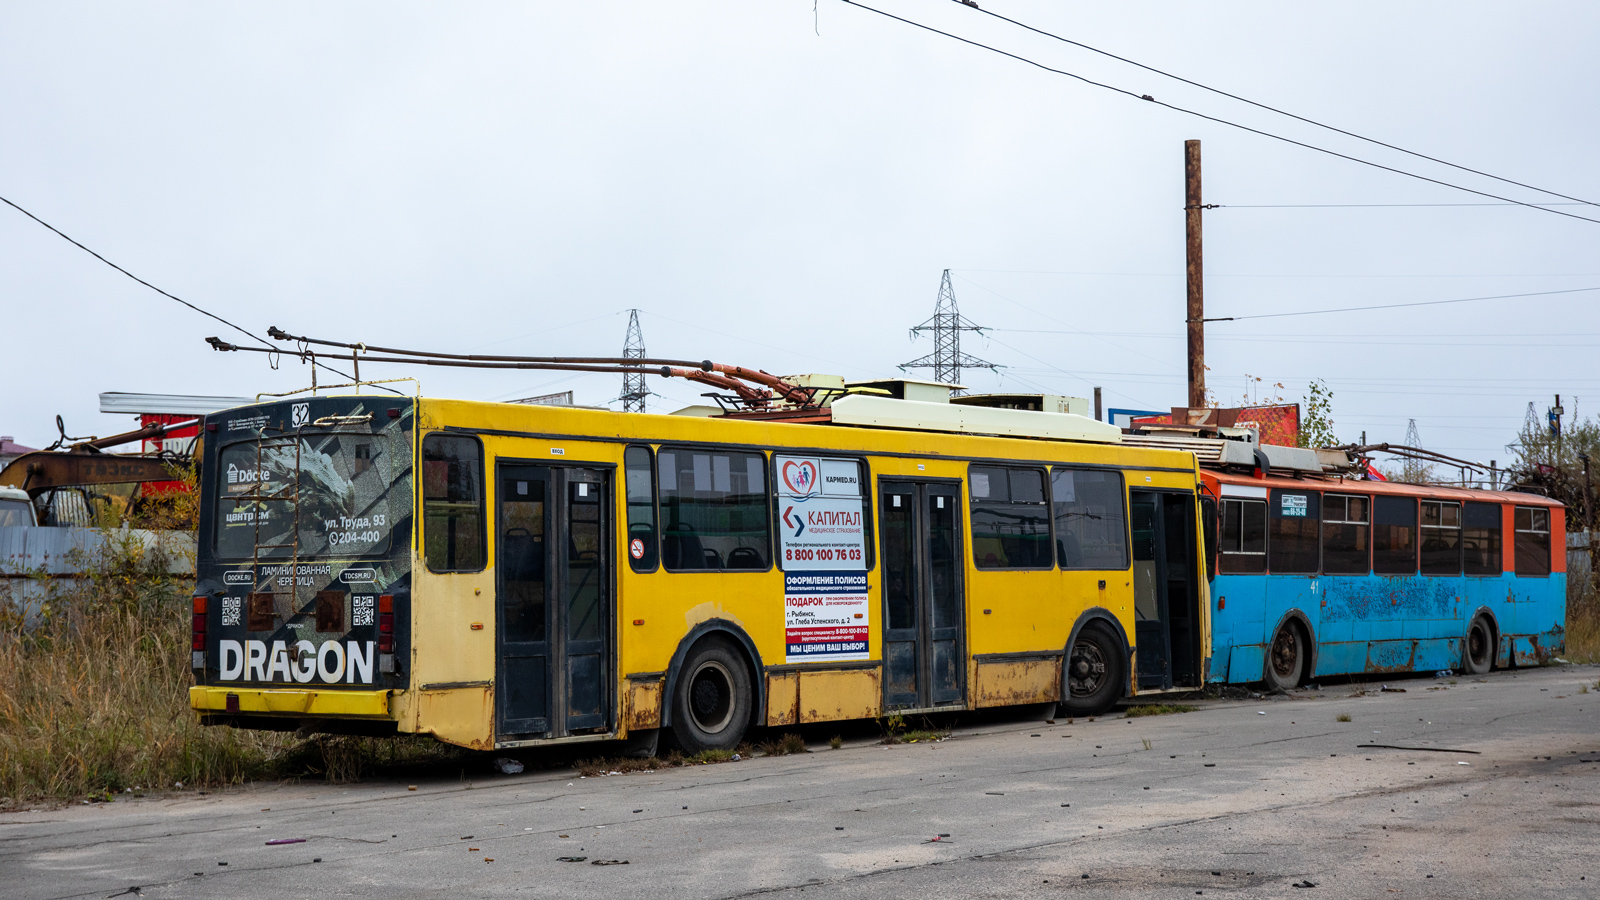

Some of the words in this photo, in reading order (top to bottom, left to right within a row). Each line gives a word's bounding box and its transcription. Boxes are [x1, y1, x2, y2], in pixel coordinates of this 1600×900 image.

[292, 404, 309, 426] 32
[239, 470, 270, 482] Döcke
[325, 520, 338, 531] ул.
[340, 516, 371, 530] Труда,
[373, 514, 385, 526] 93
[808, 511, 860, 526] КАПИТАЛ
[339, 531, 380, 543] 204-400
[786, 549, 792, 560] 8
[795, 549, 813, 560] 800
[816, 549, 833, 560] 100
[835, 549, 847, 560] 76
[849, 549, 861, 560] 03
[1310, 581, 1318, 594] 41
[786, 597, 823, 607] ПОДАРОК
[803, 644, 825, 653] ЦЕНИМ
[220, 640, 374, 684] DRAGON
